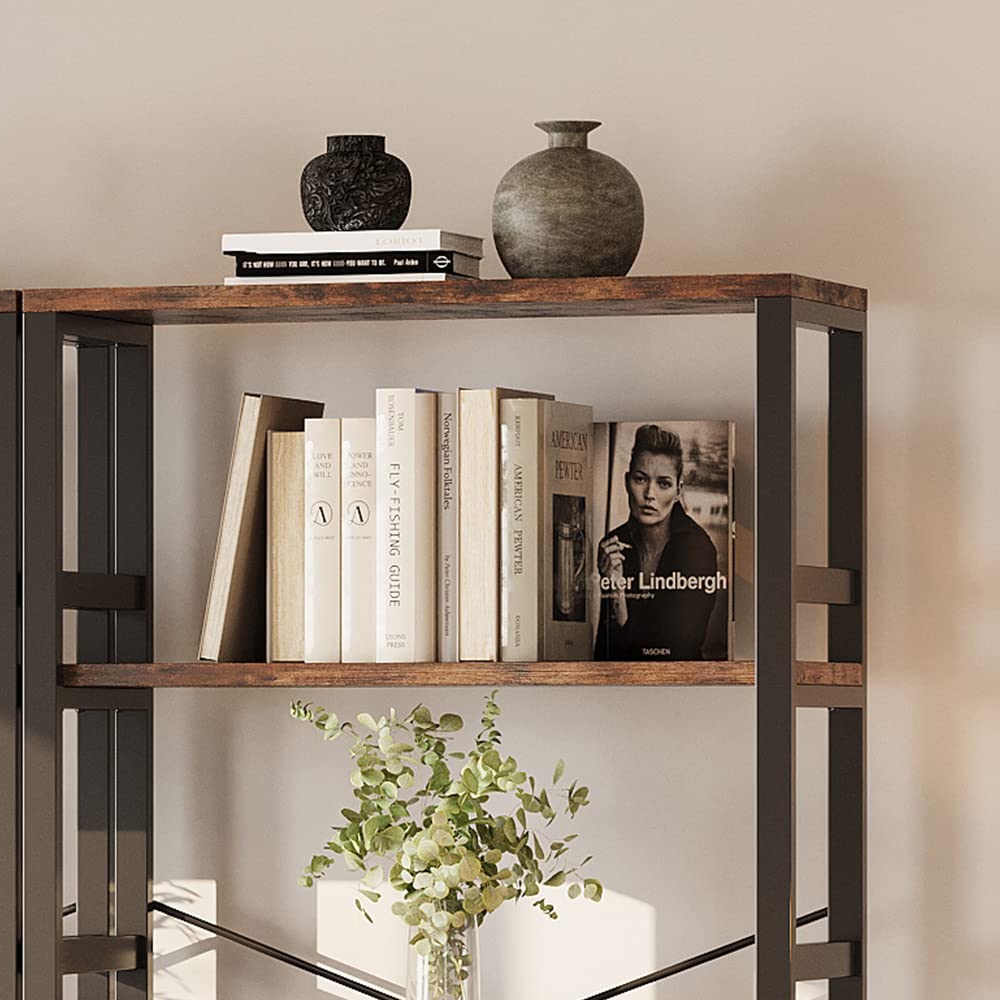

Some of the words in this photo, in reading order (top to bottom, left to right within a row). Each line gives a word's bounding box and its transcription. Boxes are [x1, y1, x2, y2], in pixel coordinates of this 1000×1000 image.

[441, 412, 453, 465] Norwegian
[551, 430, 588, 451] AMERICAN
[443, 466, 453, 510] Folktales
[555, 459, 584, 481] PEWTER
[388, 463, 401, 556] FLY-FISHING
[513, 463, 523, 522] AMERICAN
[513, 530, 523, 576] PEWTER
[388, 564, 401, 607] GUIDE
[638, 571, 728, 594] Lindbergh
[641, 647, 672, 656] TASCHEN
